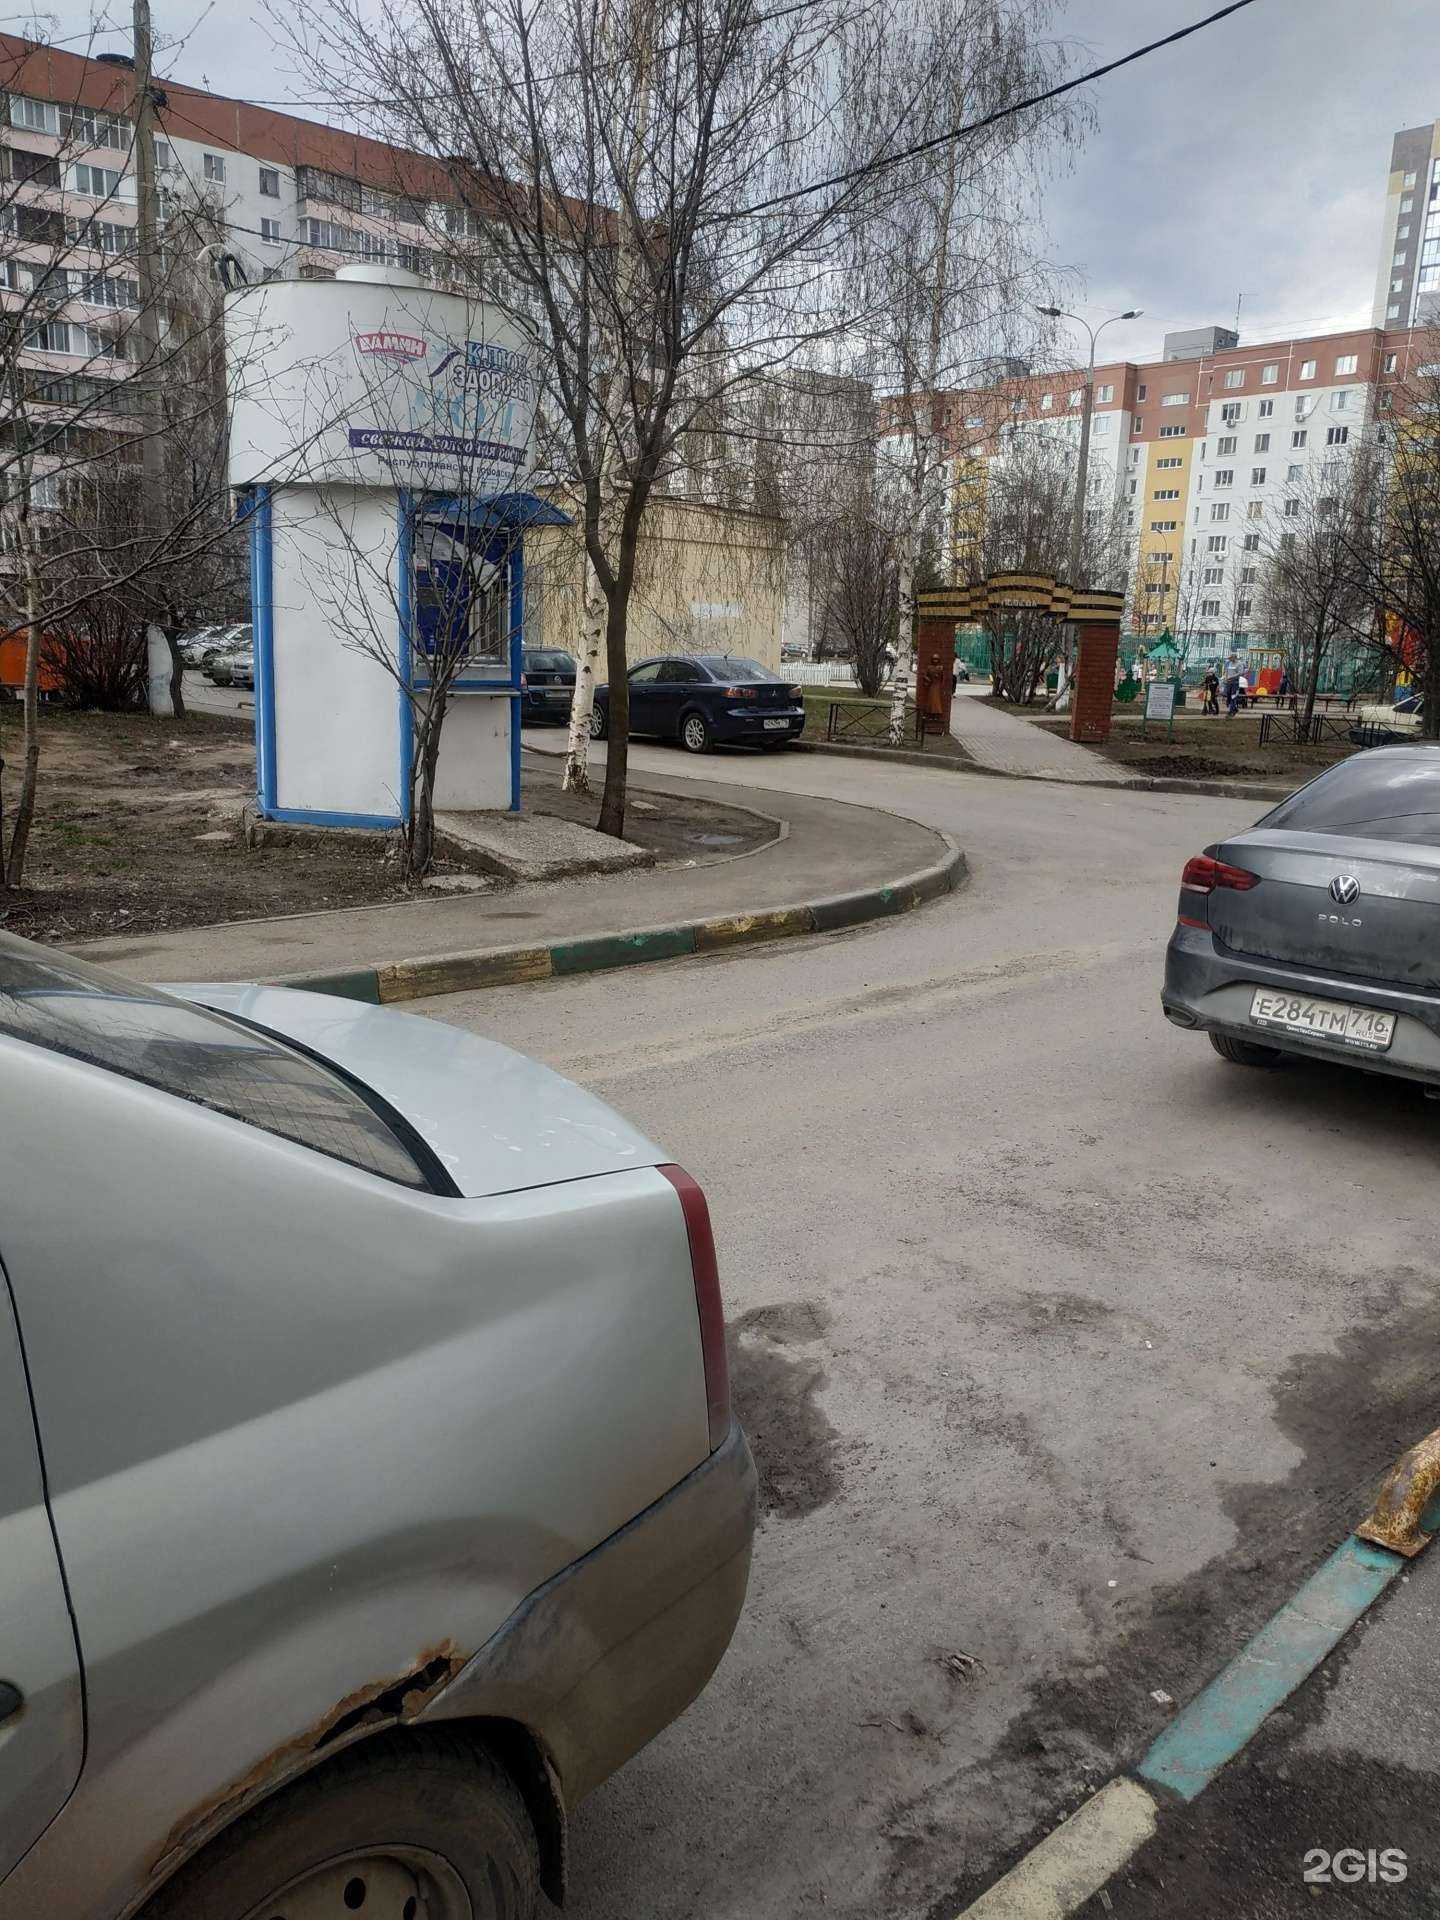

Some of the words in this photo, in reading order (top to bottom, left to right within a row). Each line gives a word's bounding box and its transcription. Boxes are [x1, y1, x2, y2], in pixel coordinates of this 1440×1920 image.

[360, 334, 423, 354] ВАМИН
[1318, 913, 1362, 927] POLO
[1351, 1009, 1385, 1033] 716
